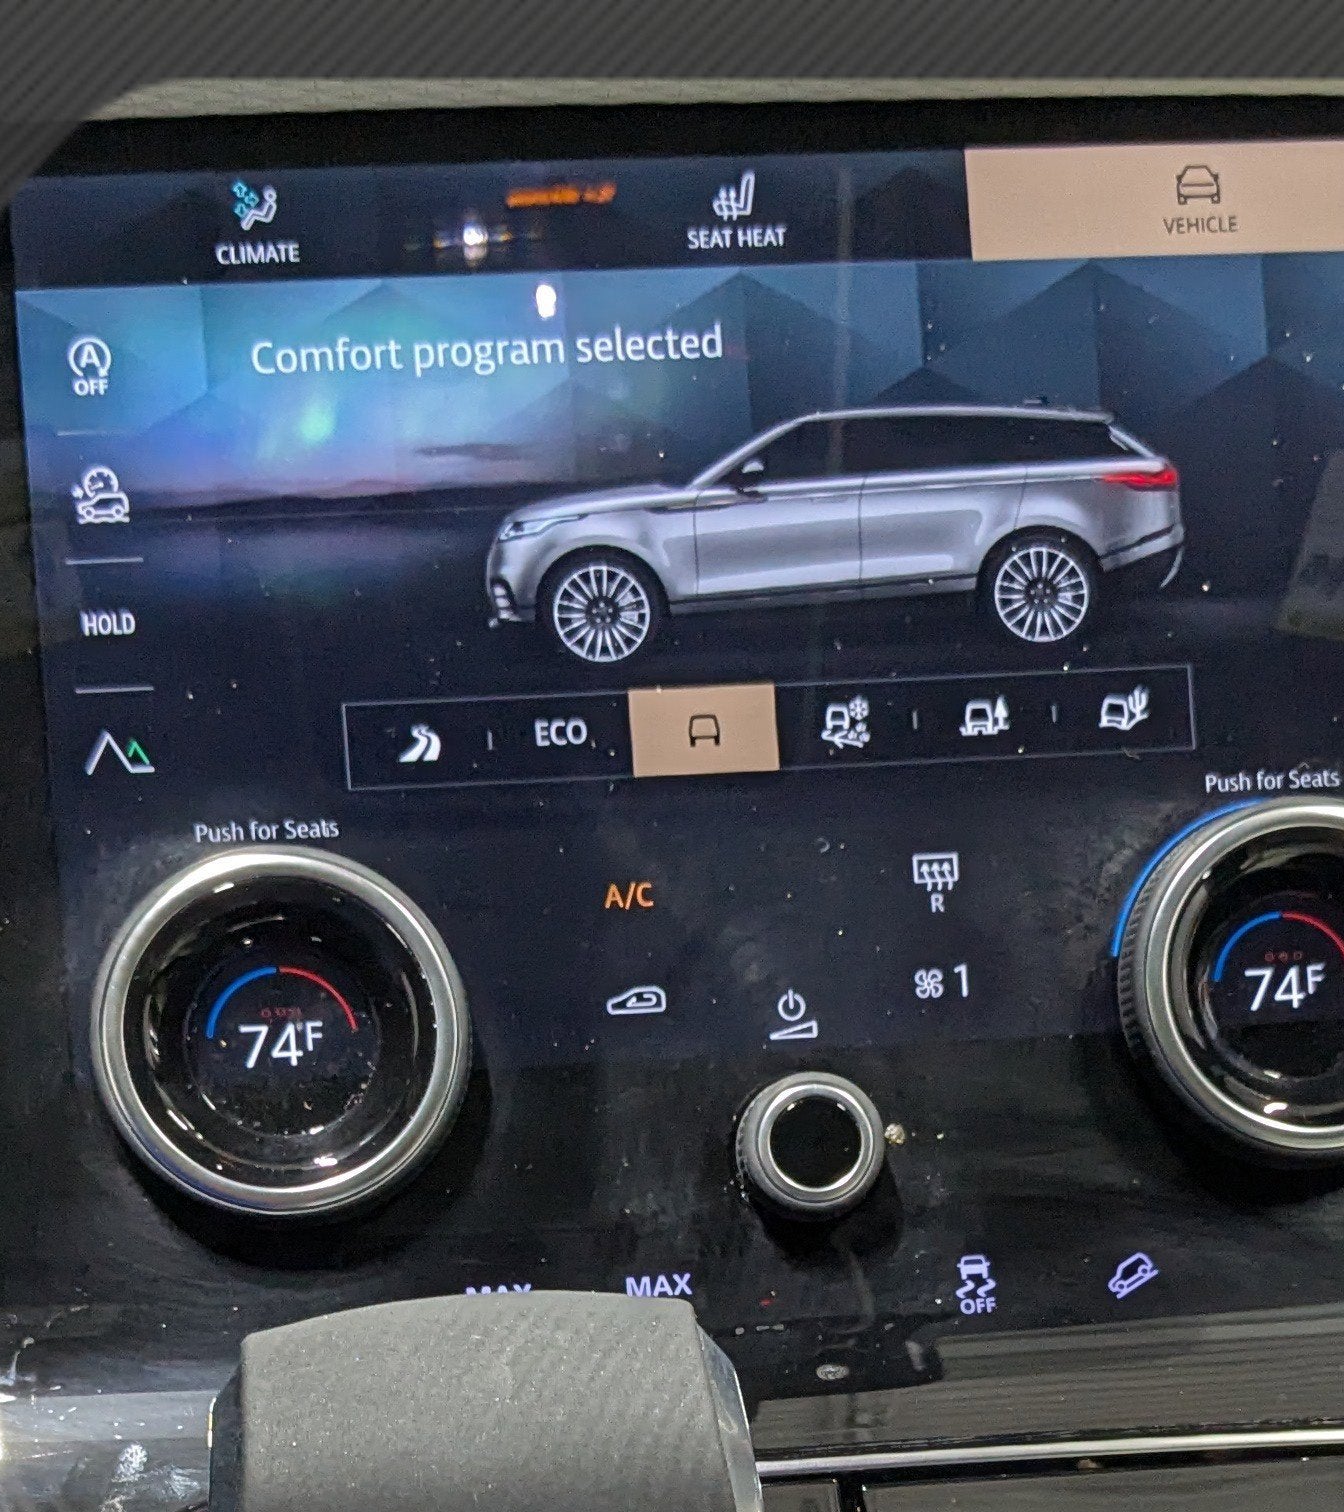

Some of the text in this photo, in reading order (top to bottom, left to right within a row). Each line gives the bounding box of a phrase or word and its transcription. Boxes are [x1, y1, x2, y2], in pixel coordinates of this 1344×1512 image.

[1163, 216, 1236, 234] VEHICLE
[687, 225, 786, 249] SEAT HEAT
[216, 243, 299, 264] CLIMATE
[251, 323, 722, 378] Comfort program selected
[73, 378, 108, 395] OFF
[81, 612, 135, 635] HOLD
[535, 719, 587, 746] ECO
[1205, 770, 1339, 793] Push for Seats
[195, 819, 339, 842] Push for Seats
[605, 882, 654, 909] A/C
[931, 894, 944, 912] R
[954, 965, 968, 997] 1
[625, 1273, 692, 1298] MAX
[959, 1299, 996, 1315] OFF
